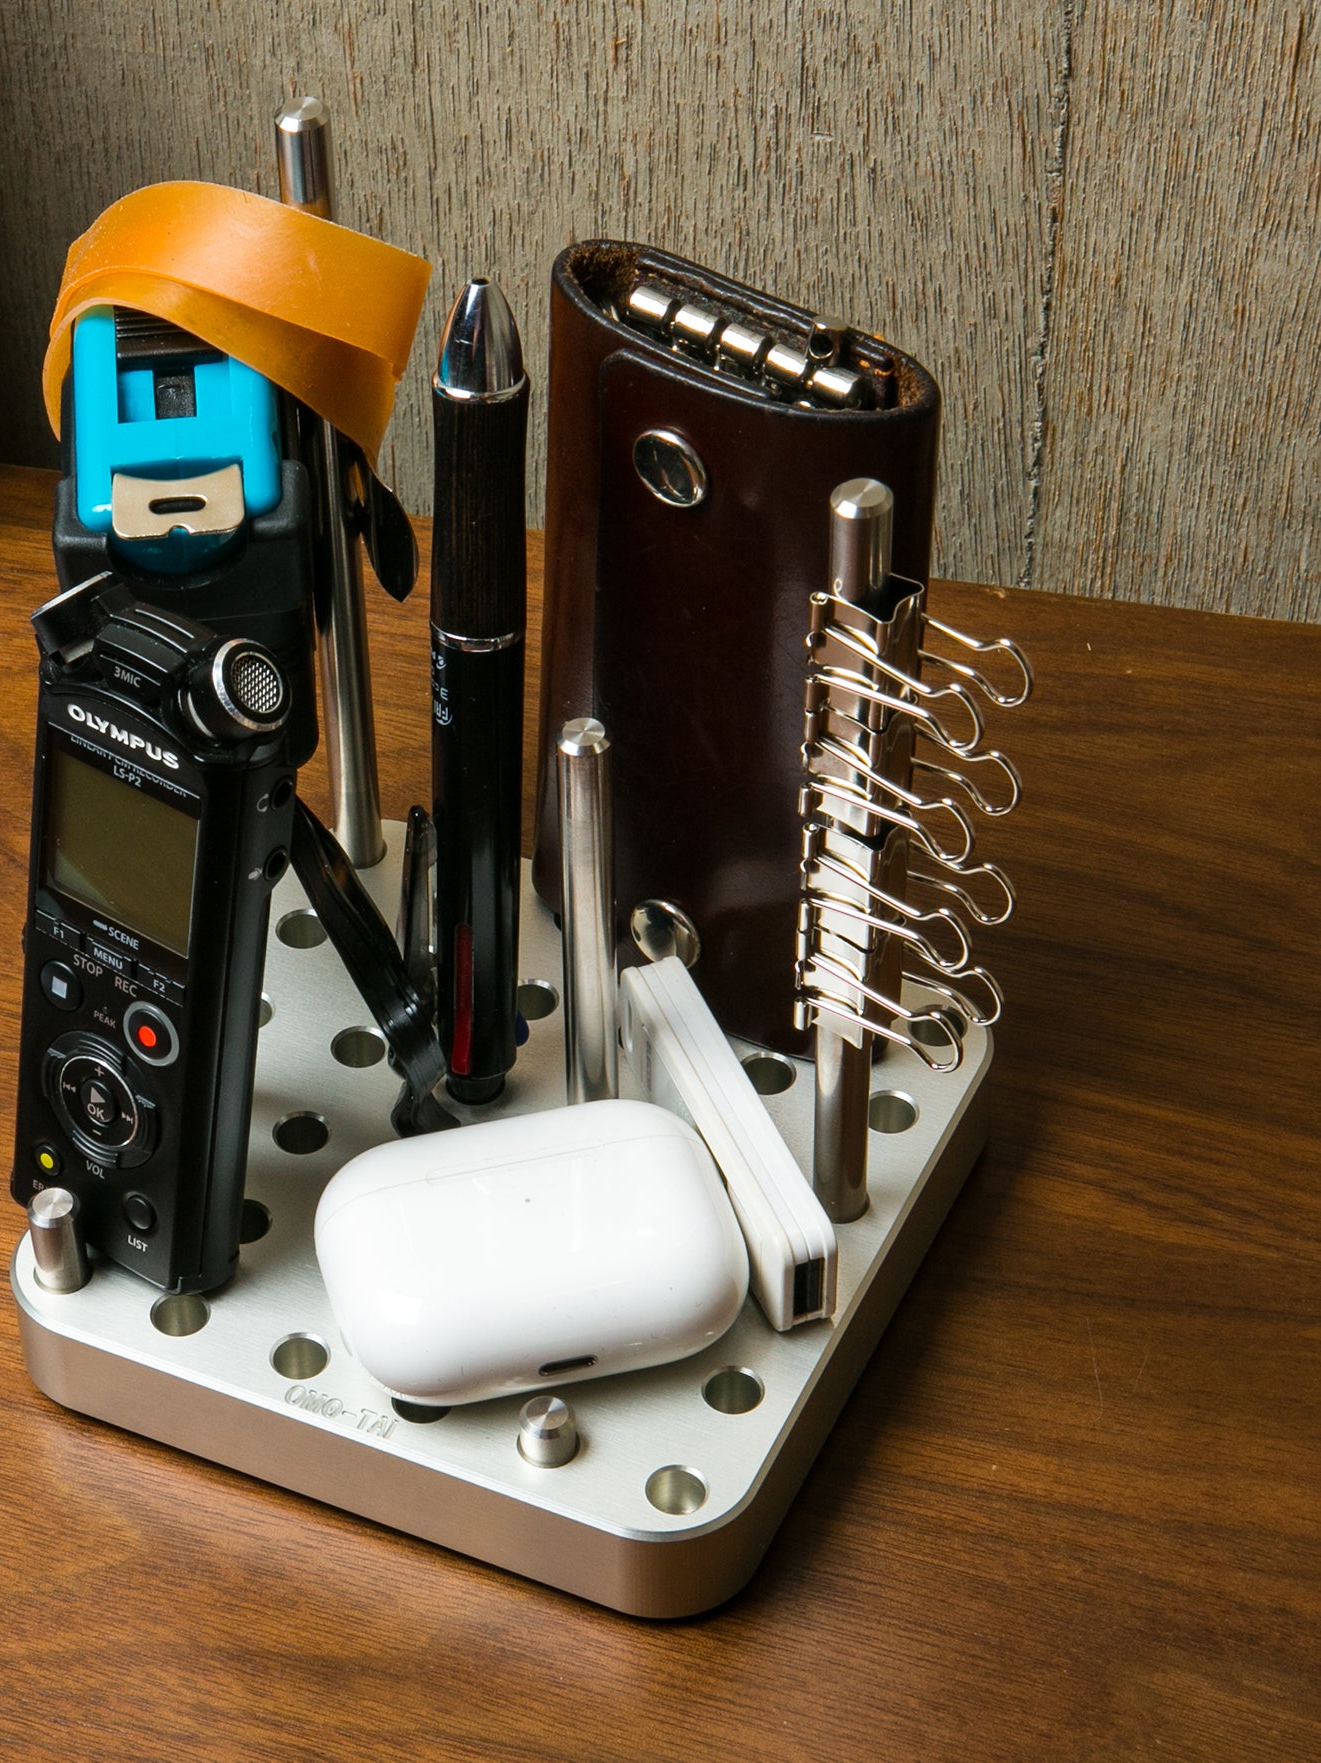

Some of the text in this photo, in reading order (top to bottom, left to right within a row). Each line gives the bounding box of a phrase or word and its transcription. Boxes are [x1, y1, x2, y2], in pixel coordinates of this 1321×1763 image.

[114, 666, 141, 688] 3MIC
[67, 704, 179, 769] OLYMPUS
[113, 765, 142, 787] LS-P2
[53, 926, 65, 939] F1
[108, 926, 140, 951] SCENE
[73, 954, 104, 978] STOP
[93, 947, 123, 970] MENU
[114, 976, 138, 998] REC
[153, 979, 166, 993] F2
[93, 1010, 117, 1029] PEAK
[87, 1103, 106, 1121] OK
[85, 1160, 106, 1180] VOL
[128, 1234, 149, 1253] LIST
